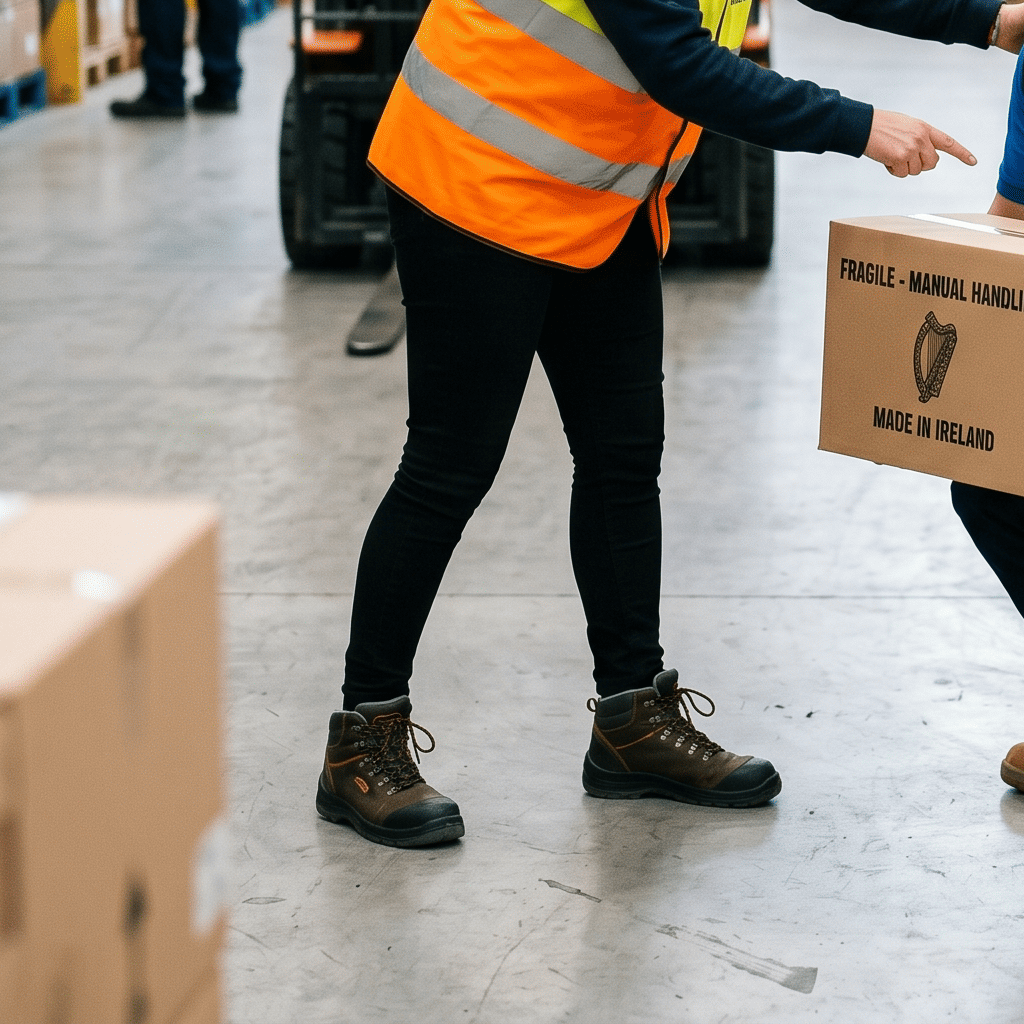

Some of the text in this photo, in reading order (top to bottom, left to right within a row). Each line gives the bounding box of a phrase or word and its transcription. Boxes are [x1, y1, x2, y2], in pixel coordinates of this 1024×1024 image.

[840, 257, 896, 288] FRAGILE
[909, 270, 967, 302] MANUAL
[873, 406, 995, 452] MADE IN IRELAND
